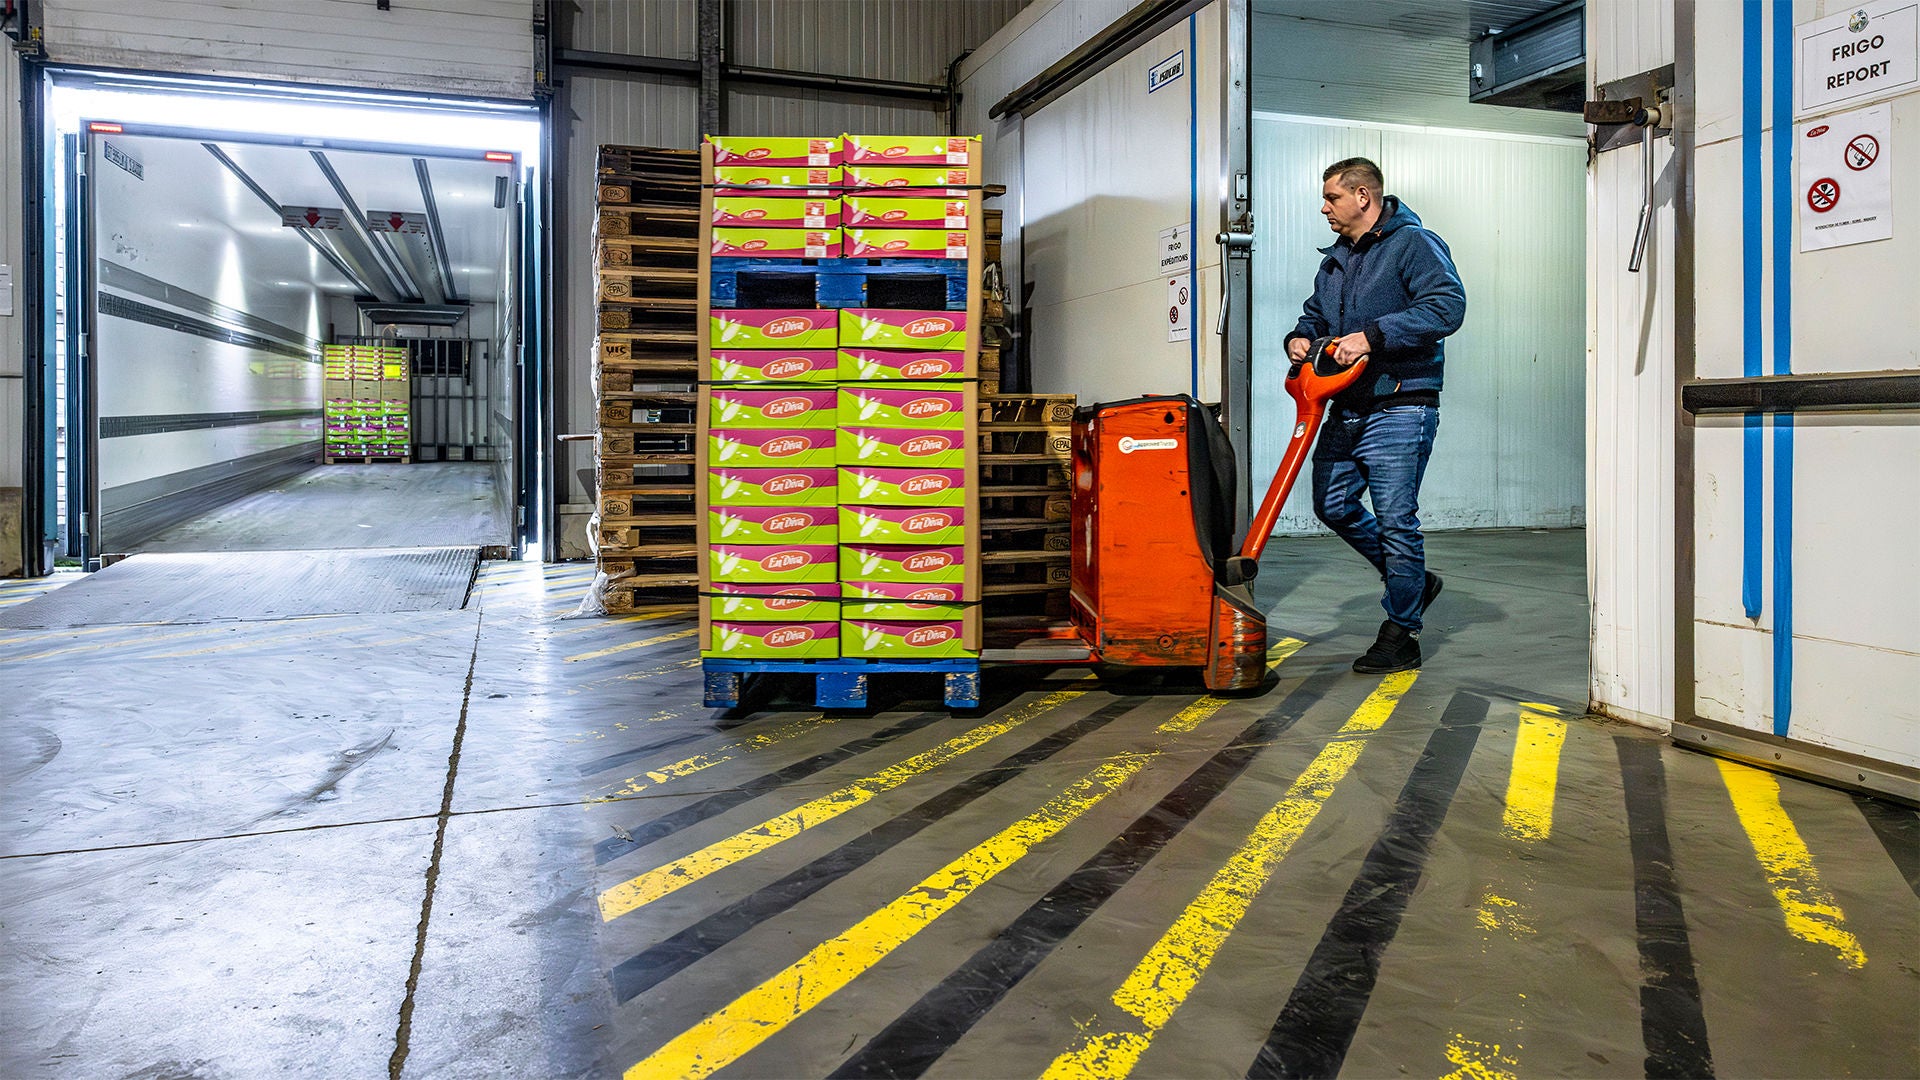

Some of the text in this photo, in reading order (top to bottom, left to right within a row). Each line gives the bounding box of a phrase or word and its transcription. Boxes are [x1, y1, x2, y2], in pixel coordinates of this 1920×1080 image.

[1831, 34, 1884, 62] FRIGO
[1827, 60, 1890, 90] REPORT
[1168, 242, 1182, 252] FRIGO
[1161, 254, 1189, 267] EXPÉDITIONS
[608, 286, 624, 294] EPAL
[610, 408, 624, 417] EPAL
[1055, 407, 1070, 416] EPAL
[1055, 440, 1071, 449] EPAL
[608, 503, 624, 512] EPAL
[1054, 570, 1069, 579] EPAL
